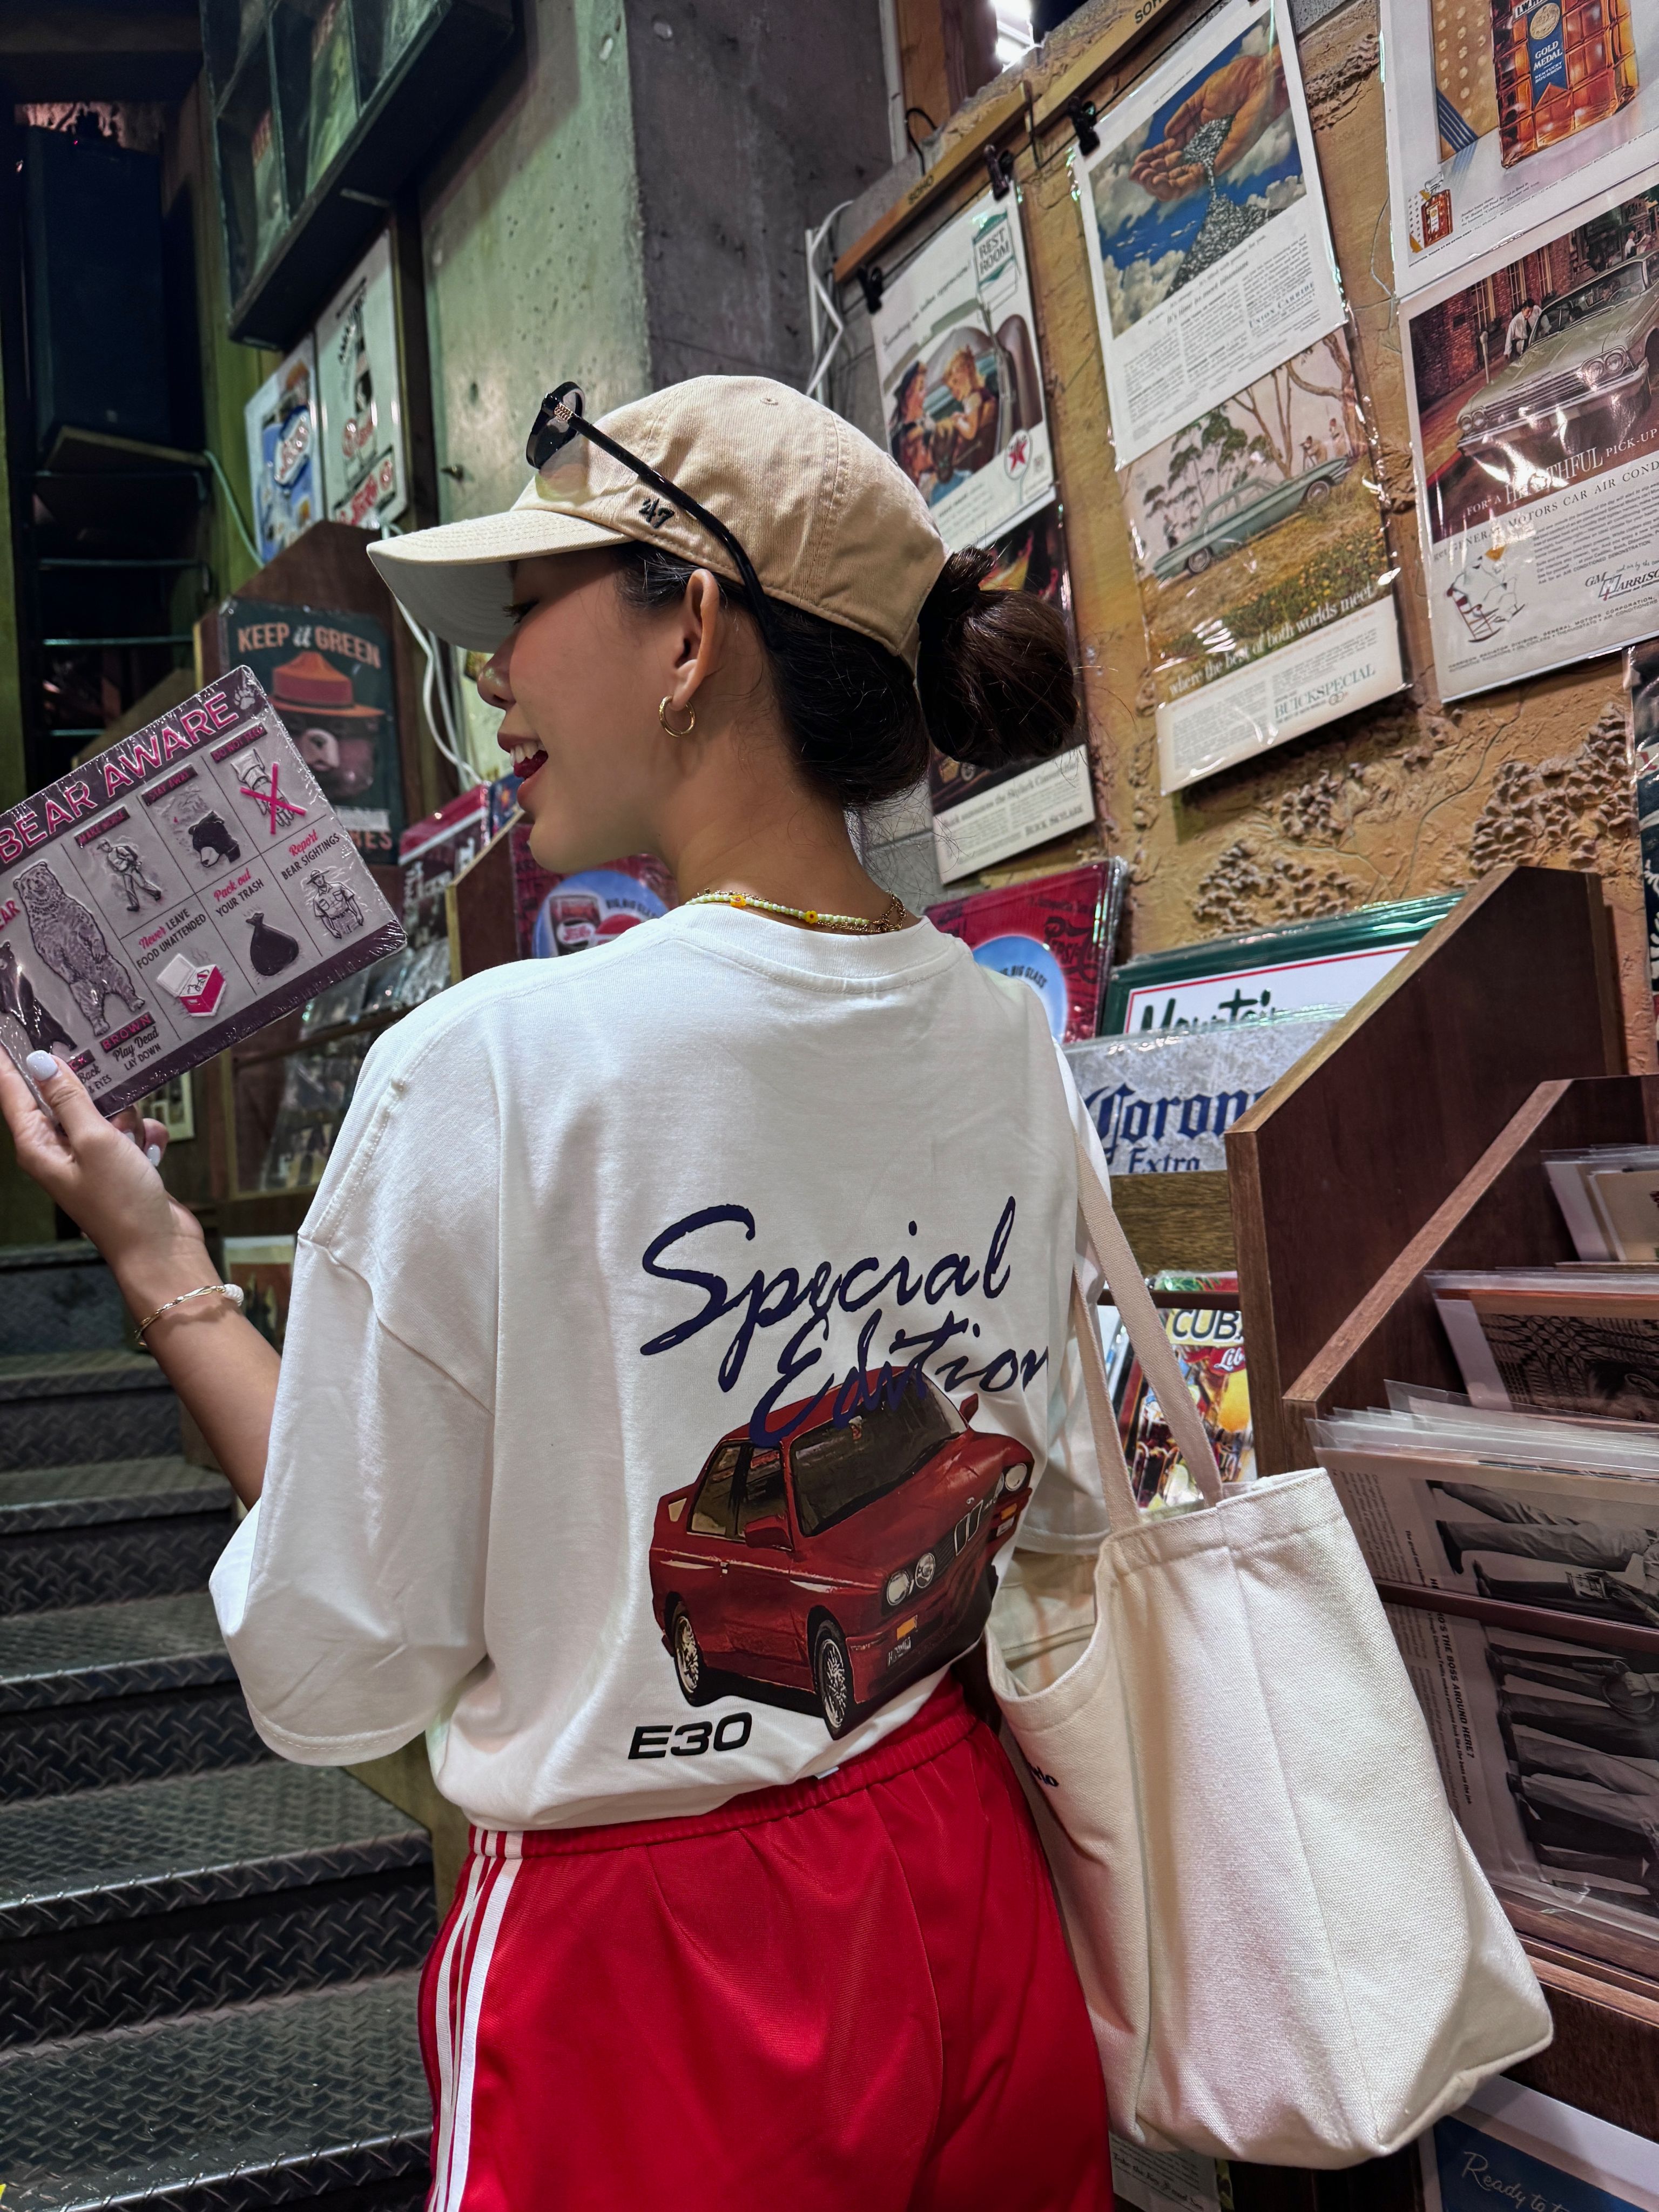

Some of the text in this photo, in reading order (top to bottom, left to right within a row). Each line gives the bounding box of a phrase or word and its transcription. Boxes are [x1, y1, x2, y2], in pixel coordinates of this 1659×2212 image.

[1135, 0, 1163, 24] SOH
[1533, 49, 1563, 71] MEDAL
[1535, 41, 1559, 59] GOLD
[1534, 62, 1562, 79] KENTUCKY
[908, 174, 935, 206] SOHO
[979, 227, 1005, 260] REST
[980, 240, 1010, 275] ROOM
[1467, 502, 1488, 516] FOR
[1606, 428, 1658, 457] PICK-UP
[1508, 503, 1559, 529] MOTORS
[1563, 489, 1588, 507] CAR
[1594, 478, 1617, 495] AIR
[1622, 460, 1659, 483] COND
[638, 498, 675, 529] 47
[1584, 570, 1608, 588] GM
[1600, 568, 1659, 595] HARRISO
[238, 622, 382, 670] KEEP it GREEN
[1169, 672, 1204, 697] where
[1204, 660, 1223, 683] the
[1252, 637, 1265, 655] of
[1267, 624, 1295, 647] both
[1295, 599, 1339, 633] worlds
[1339, 584, 1373, 611] meet
[0, 691, 239, 864] BEAR AWARE
[281, 833, 341, 880] BEAR SIGHTINGS
[288, 829, 319, 857] Report
[213, 868, 252, 902] Pack out
[215, 878, 264, 918] YOUR TRASH
[136, 913, 207, 970] FOOD UNATTENDED
[138, 908, 190, 949] Never LEAVE
[1011, 965, 1048, 989] BIG GLASS
[102, 1013, 152, 1050] BROWN
[112, 1027, 159, 1063] Play Dead
[69, 1056, 87, 1071] CK
[124, 1043, 162, 1071] LAY DOWN
[95, 1074, 112, 1090] EYES
[1085, 1082, 1271, 1165] Coron
[640, 1195, 1016, 1393] Special
[1172, 1309, 1244, 1343] CUB
[1214, 1346, 1246, 1372] Lib
[747, 1307, 1049, 1451] Edition
[1441, 1634, 1453, 1653] THE
[1446, 1654, 1458, 1681] BOSS
[1452, 1682, 1467, 1724] AROUND
[628, 1711, 752, 1759] E30
[1451, 1723, 1459, 1736] look
[1461, 1726, 1474, 1759] HERE?
[1461, 2151, 1547, 2212] Ready to
